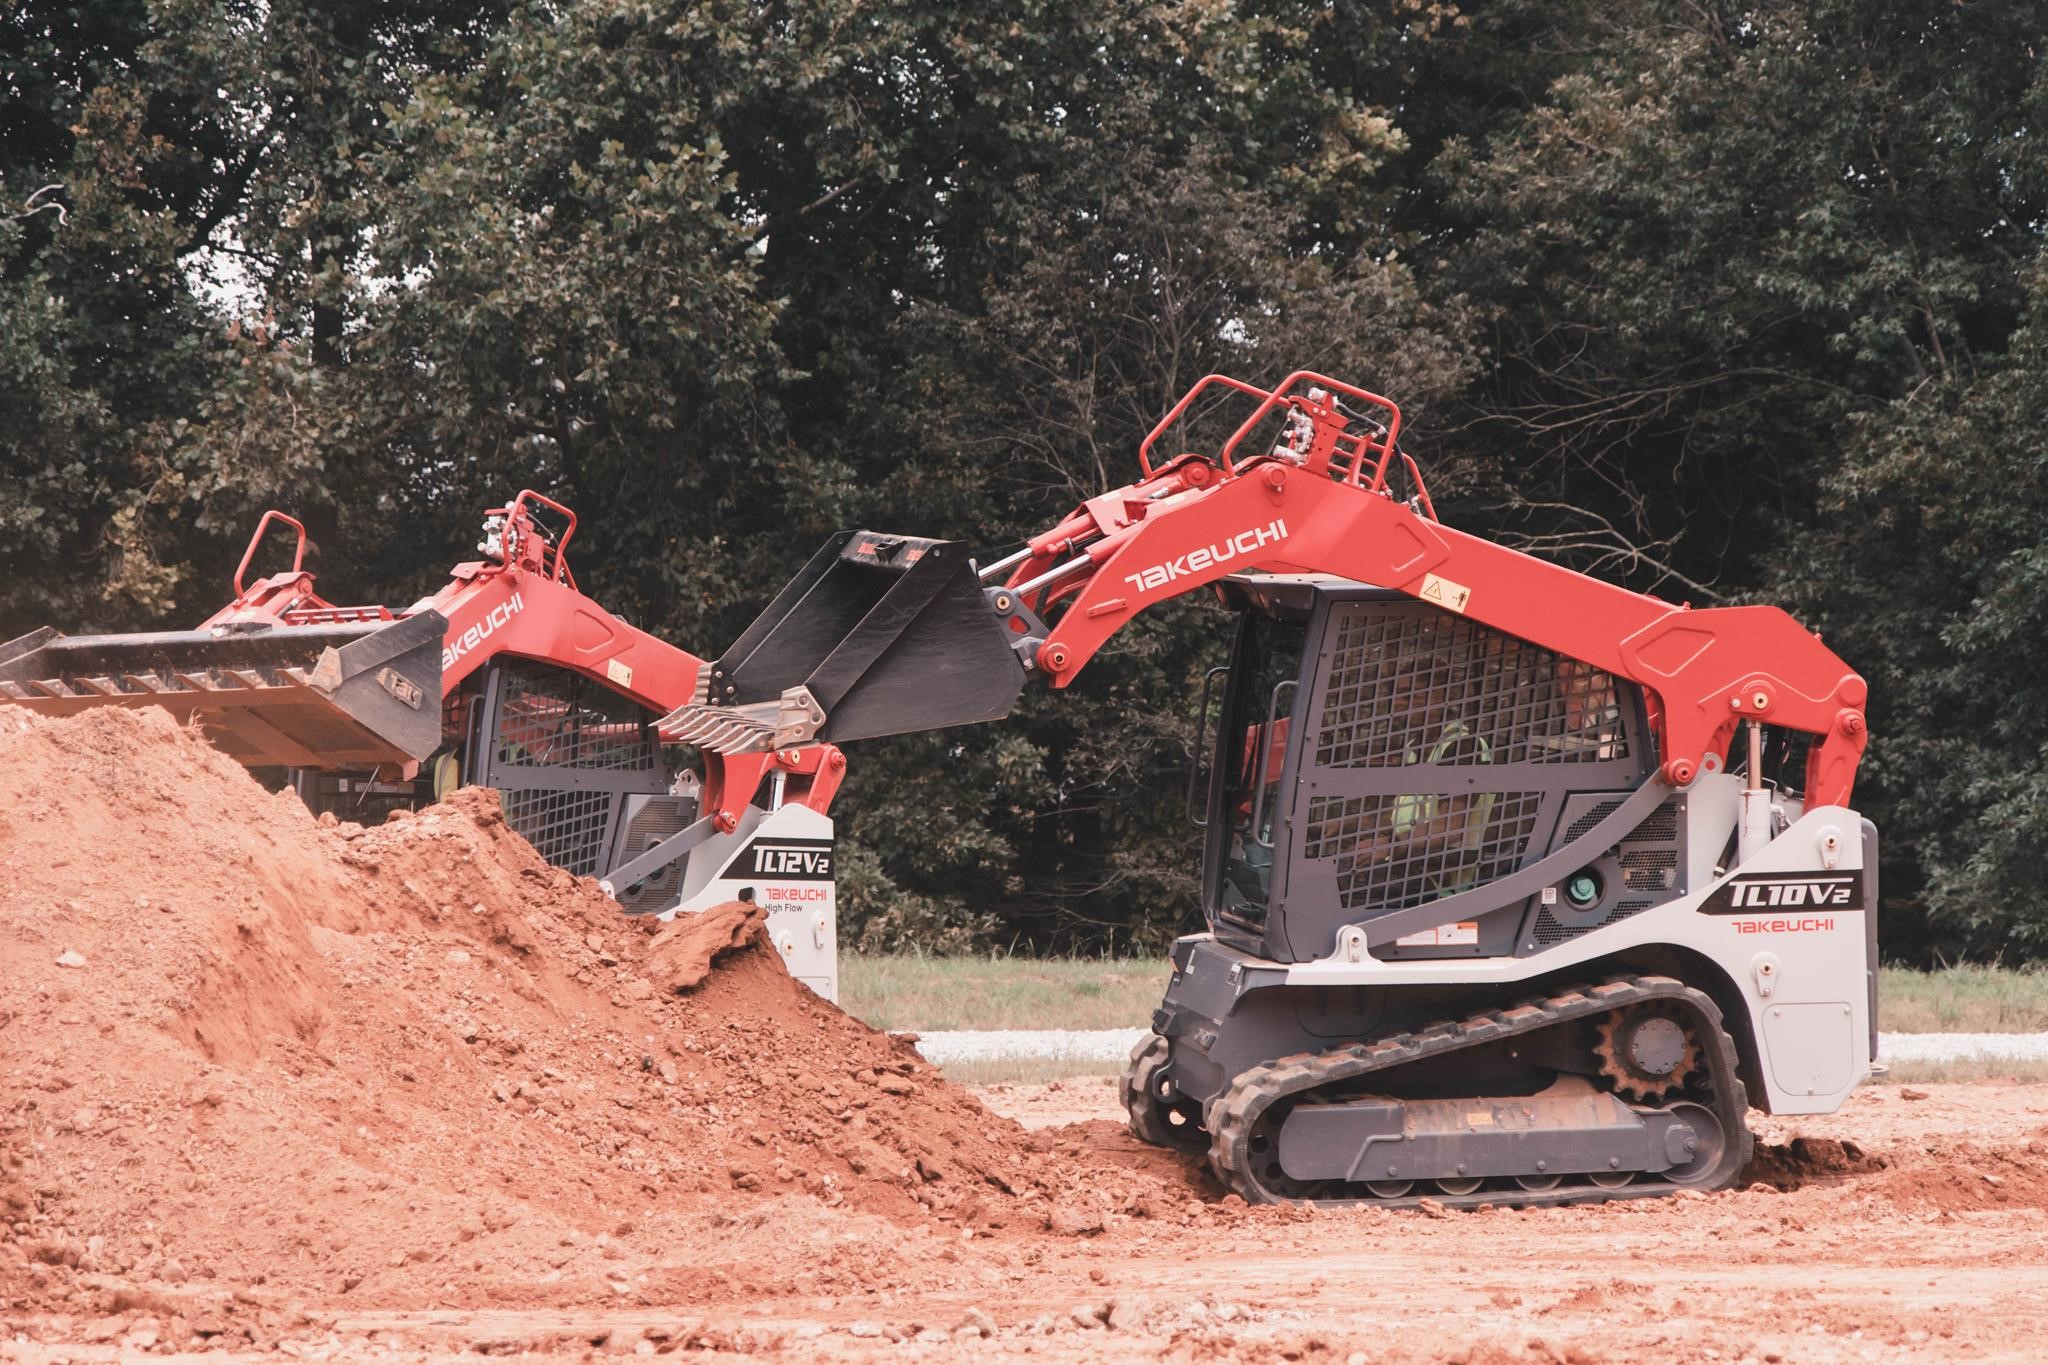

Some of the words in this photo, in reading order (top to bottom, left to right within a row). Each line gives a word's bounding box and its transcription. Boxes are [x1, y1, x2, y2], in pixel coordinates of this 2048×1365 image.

[442, 591, 525, 671] AKEUCHI
[753, 845, 832, 873] TL12V2
[1729, 877, 1854, 907] TL10V2
[764, 903, 783, 914] High
[784, 903, 803, 912] Flow
